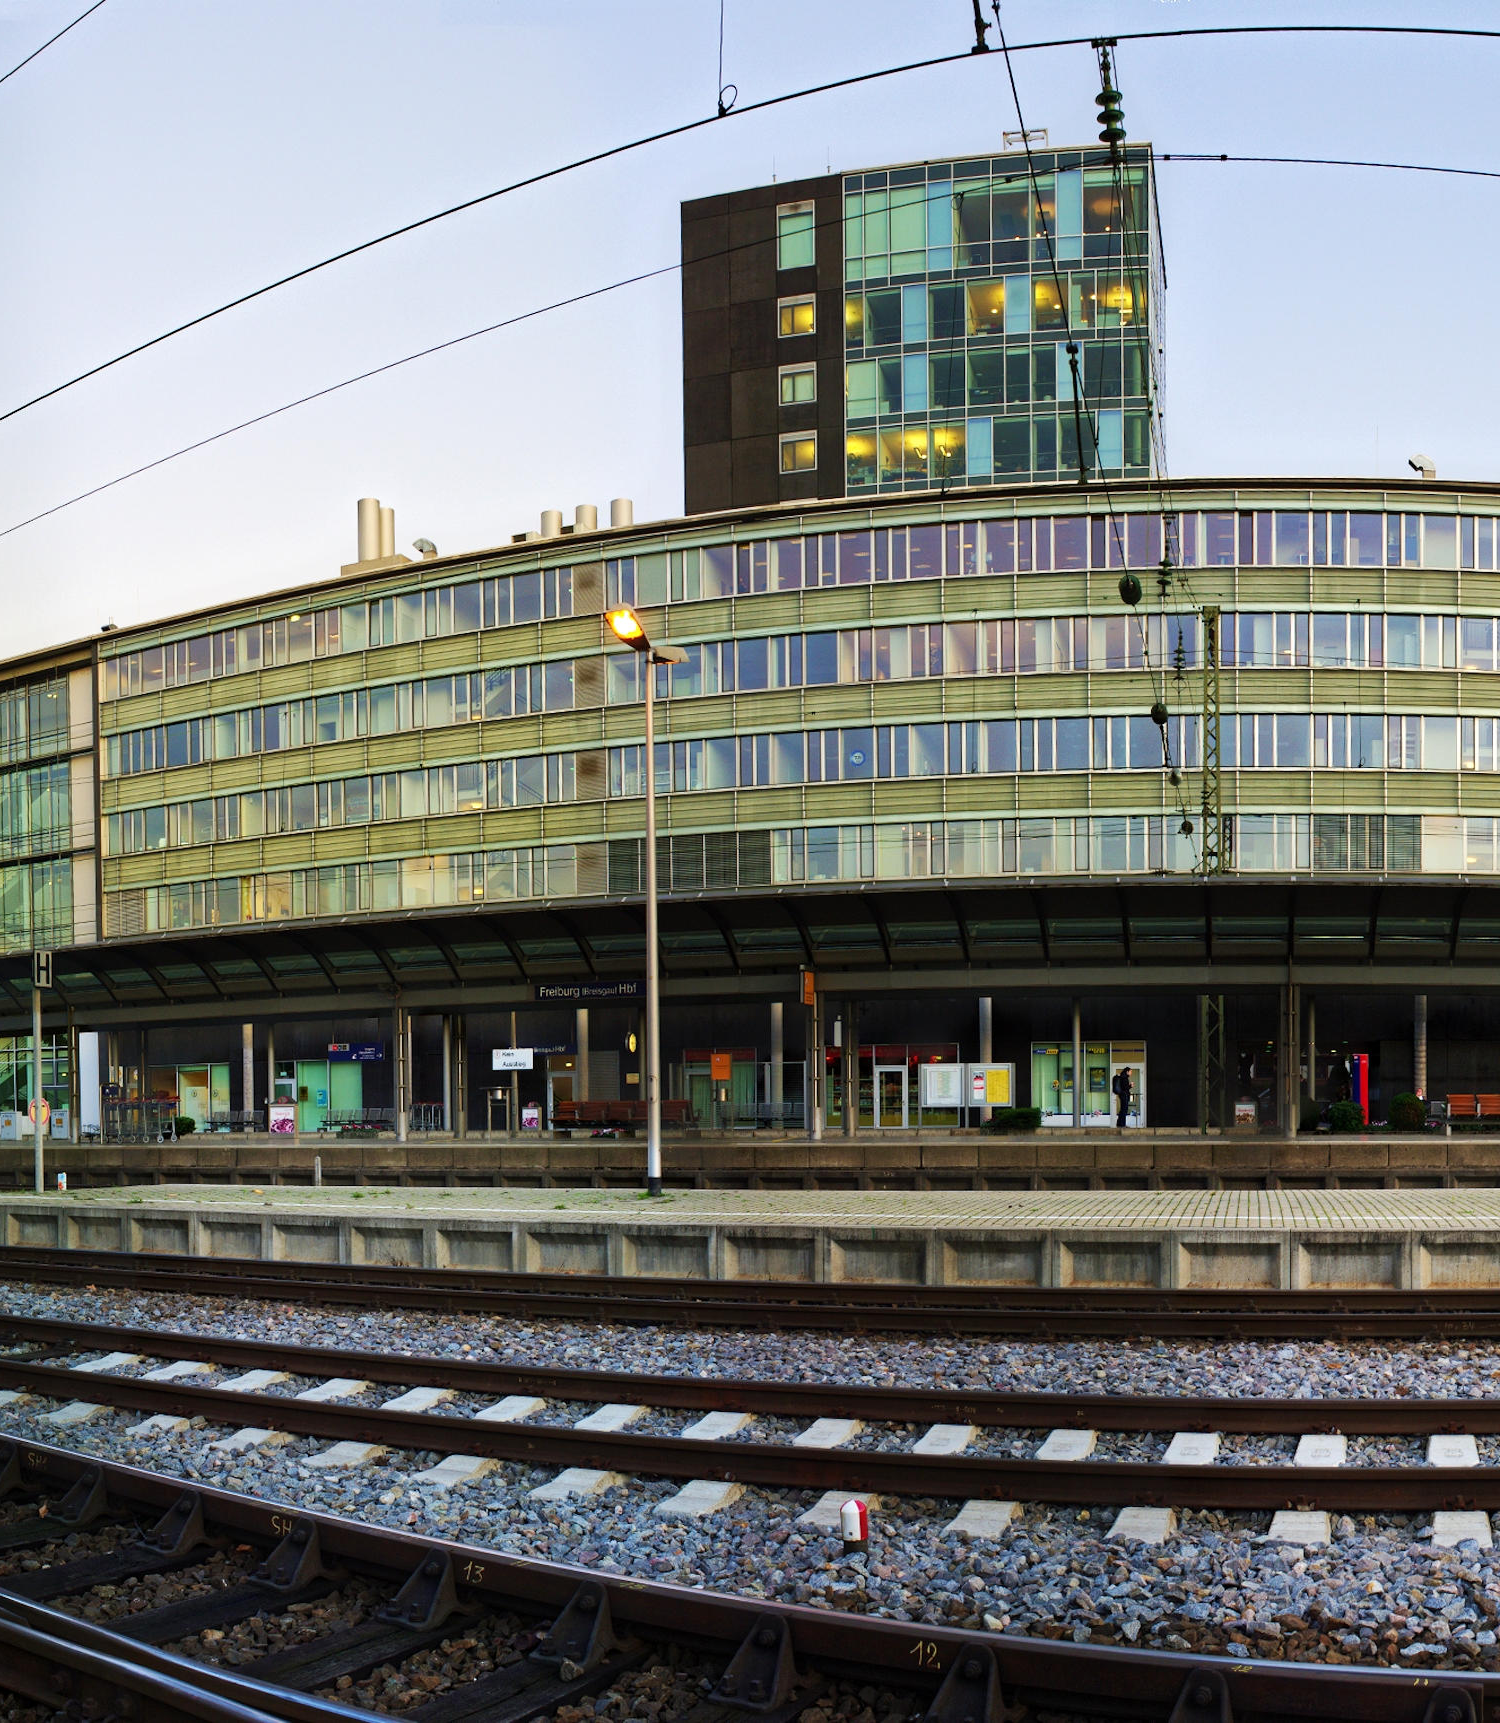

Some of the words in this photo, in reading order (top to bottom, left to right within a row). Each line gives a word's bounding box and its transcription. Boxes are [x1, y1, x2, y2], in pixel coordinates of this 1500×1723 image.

[36, 953, 50, 985] H
[540, 986, 580, 998] Freiburg
[619, 982, 637, 994] Hbf
[463, 1561, 485, 1583] 13
[910, 1640, 940, 1670] 12
